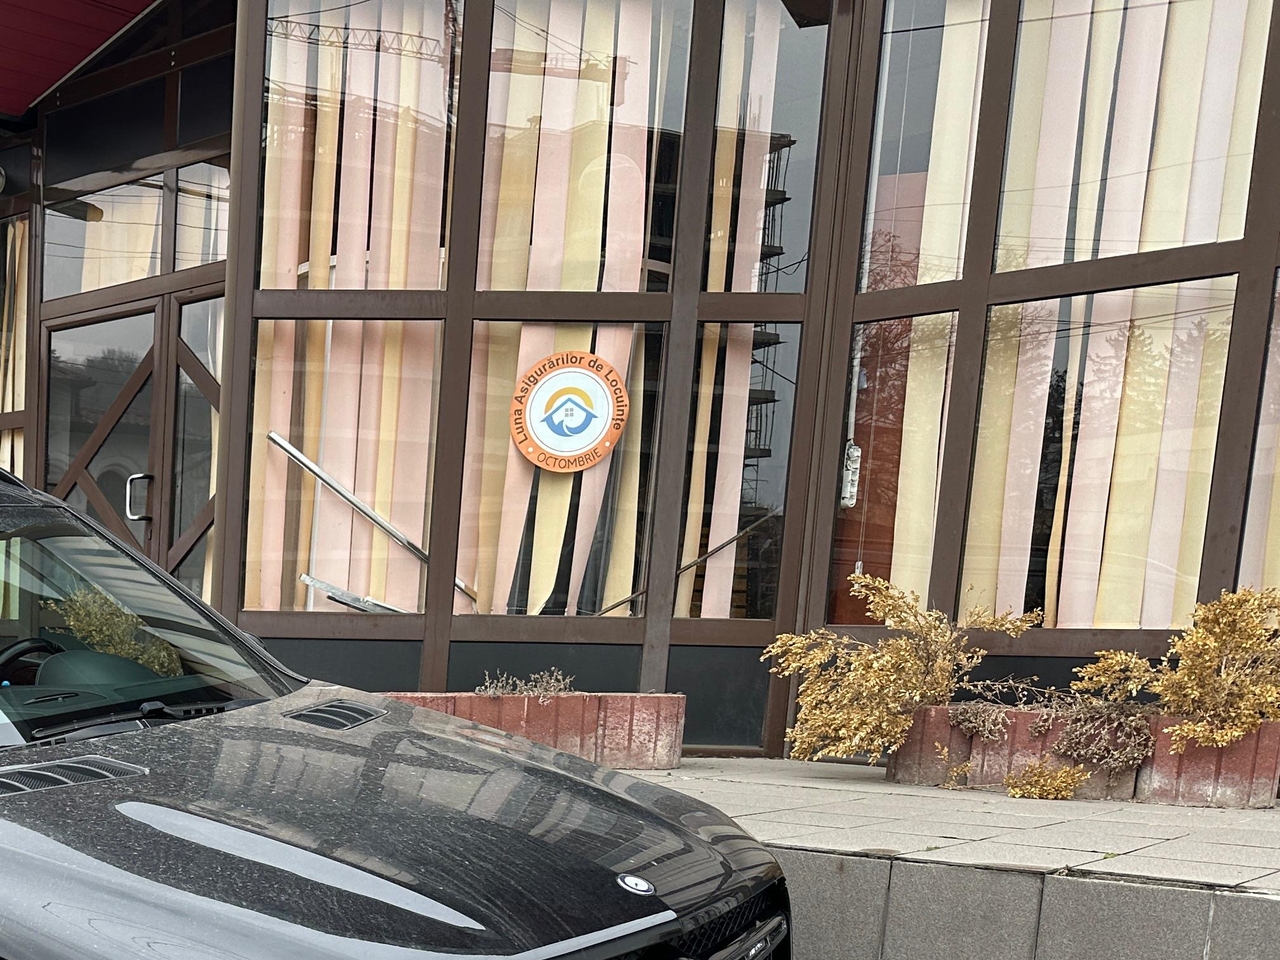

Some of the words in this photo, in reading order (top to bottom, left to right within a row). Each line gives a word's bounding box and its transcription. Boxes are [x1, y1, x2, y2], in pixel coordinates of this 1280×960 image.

[514, 353, 585, 405] Asigurărilor
[588, 358, 603, 372] de
[513, 408, 528, 444] Luna
[537, 447, 603, 469] OCTOMBRIE
